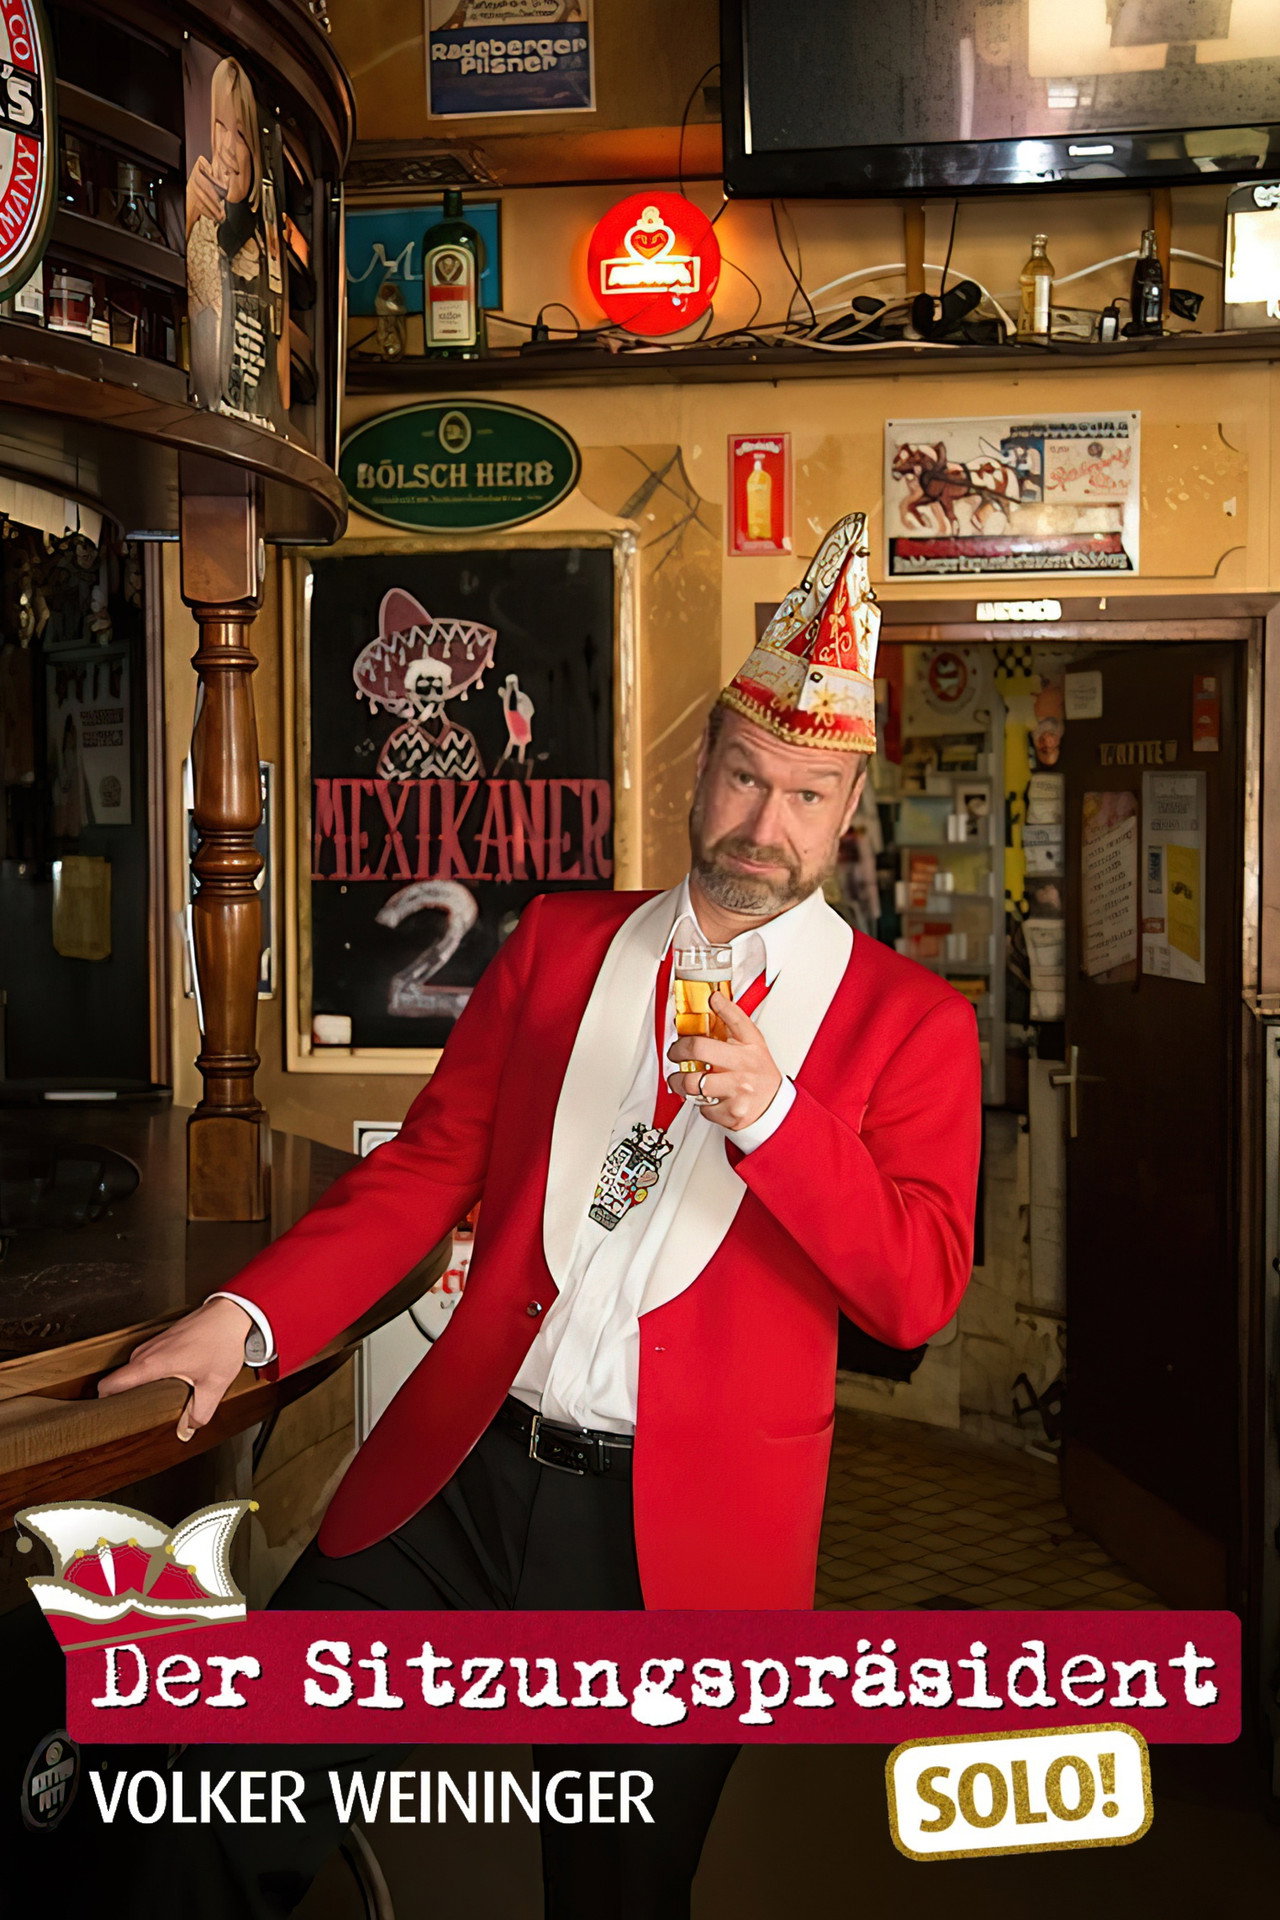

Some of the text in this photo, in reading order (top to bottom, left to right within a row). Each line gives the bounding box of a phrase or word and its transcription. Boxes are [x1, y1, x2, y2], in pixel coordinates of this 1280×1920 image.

[0, 63, 34, 125] 'S
[460, 55, 558, 75] Pilsner
[476, 460, 554, 487] HERB
[311, 777, 614, 881] MEXIKANER
[375, 880, 479, 1018] 2
